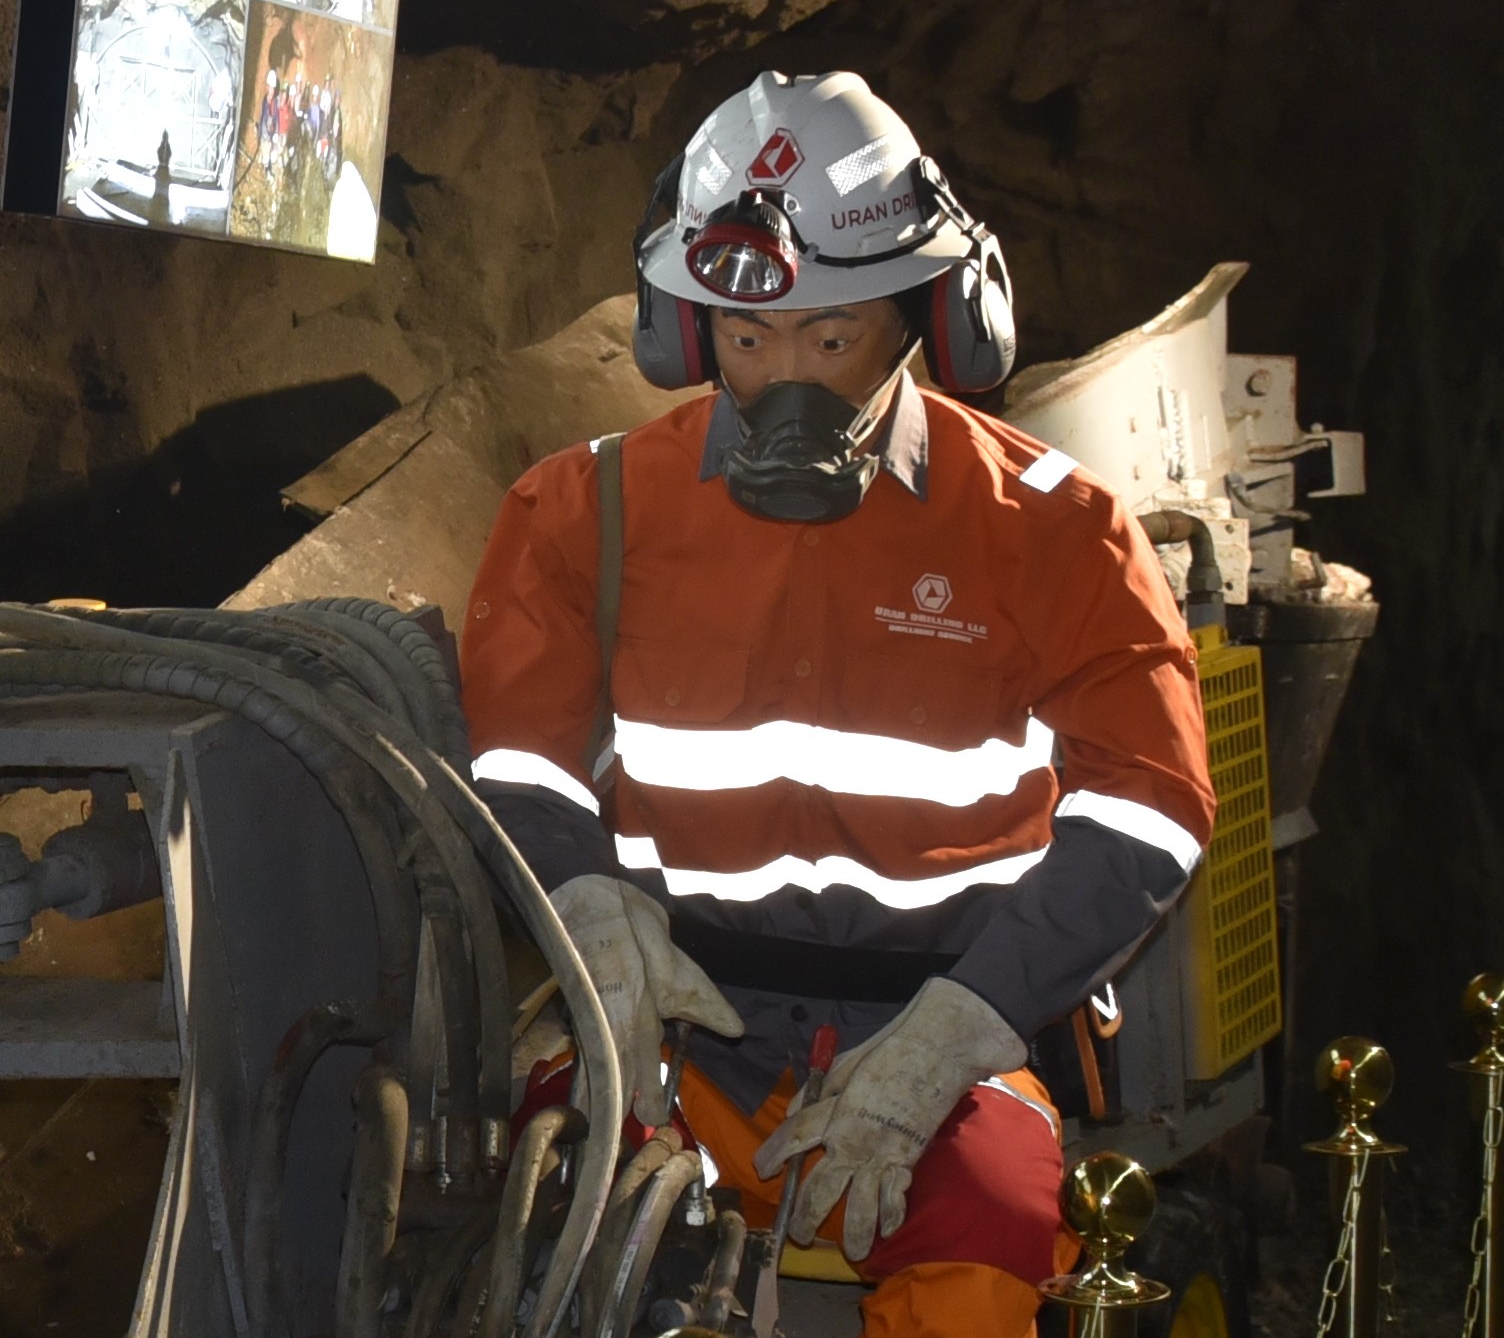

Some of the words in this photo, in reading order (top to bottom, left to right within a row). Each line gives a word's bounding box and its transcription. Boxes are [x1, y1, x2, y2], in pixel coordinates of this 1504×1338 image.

[831, 202, 888, 230] URAN
[875, 606, 906, 621] URAN
[910, 613, 963, 629] DRILLING
[967, 623, 988, 635] LLC
